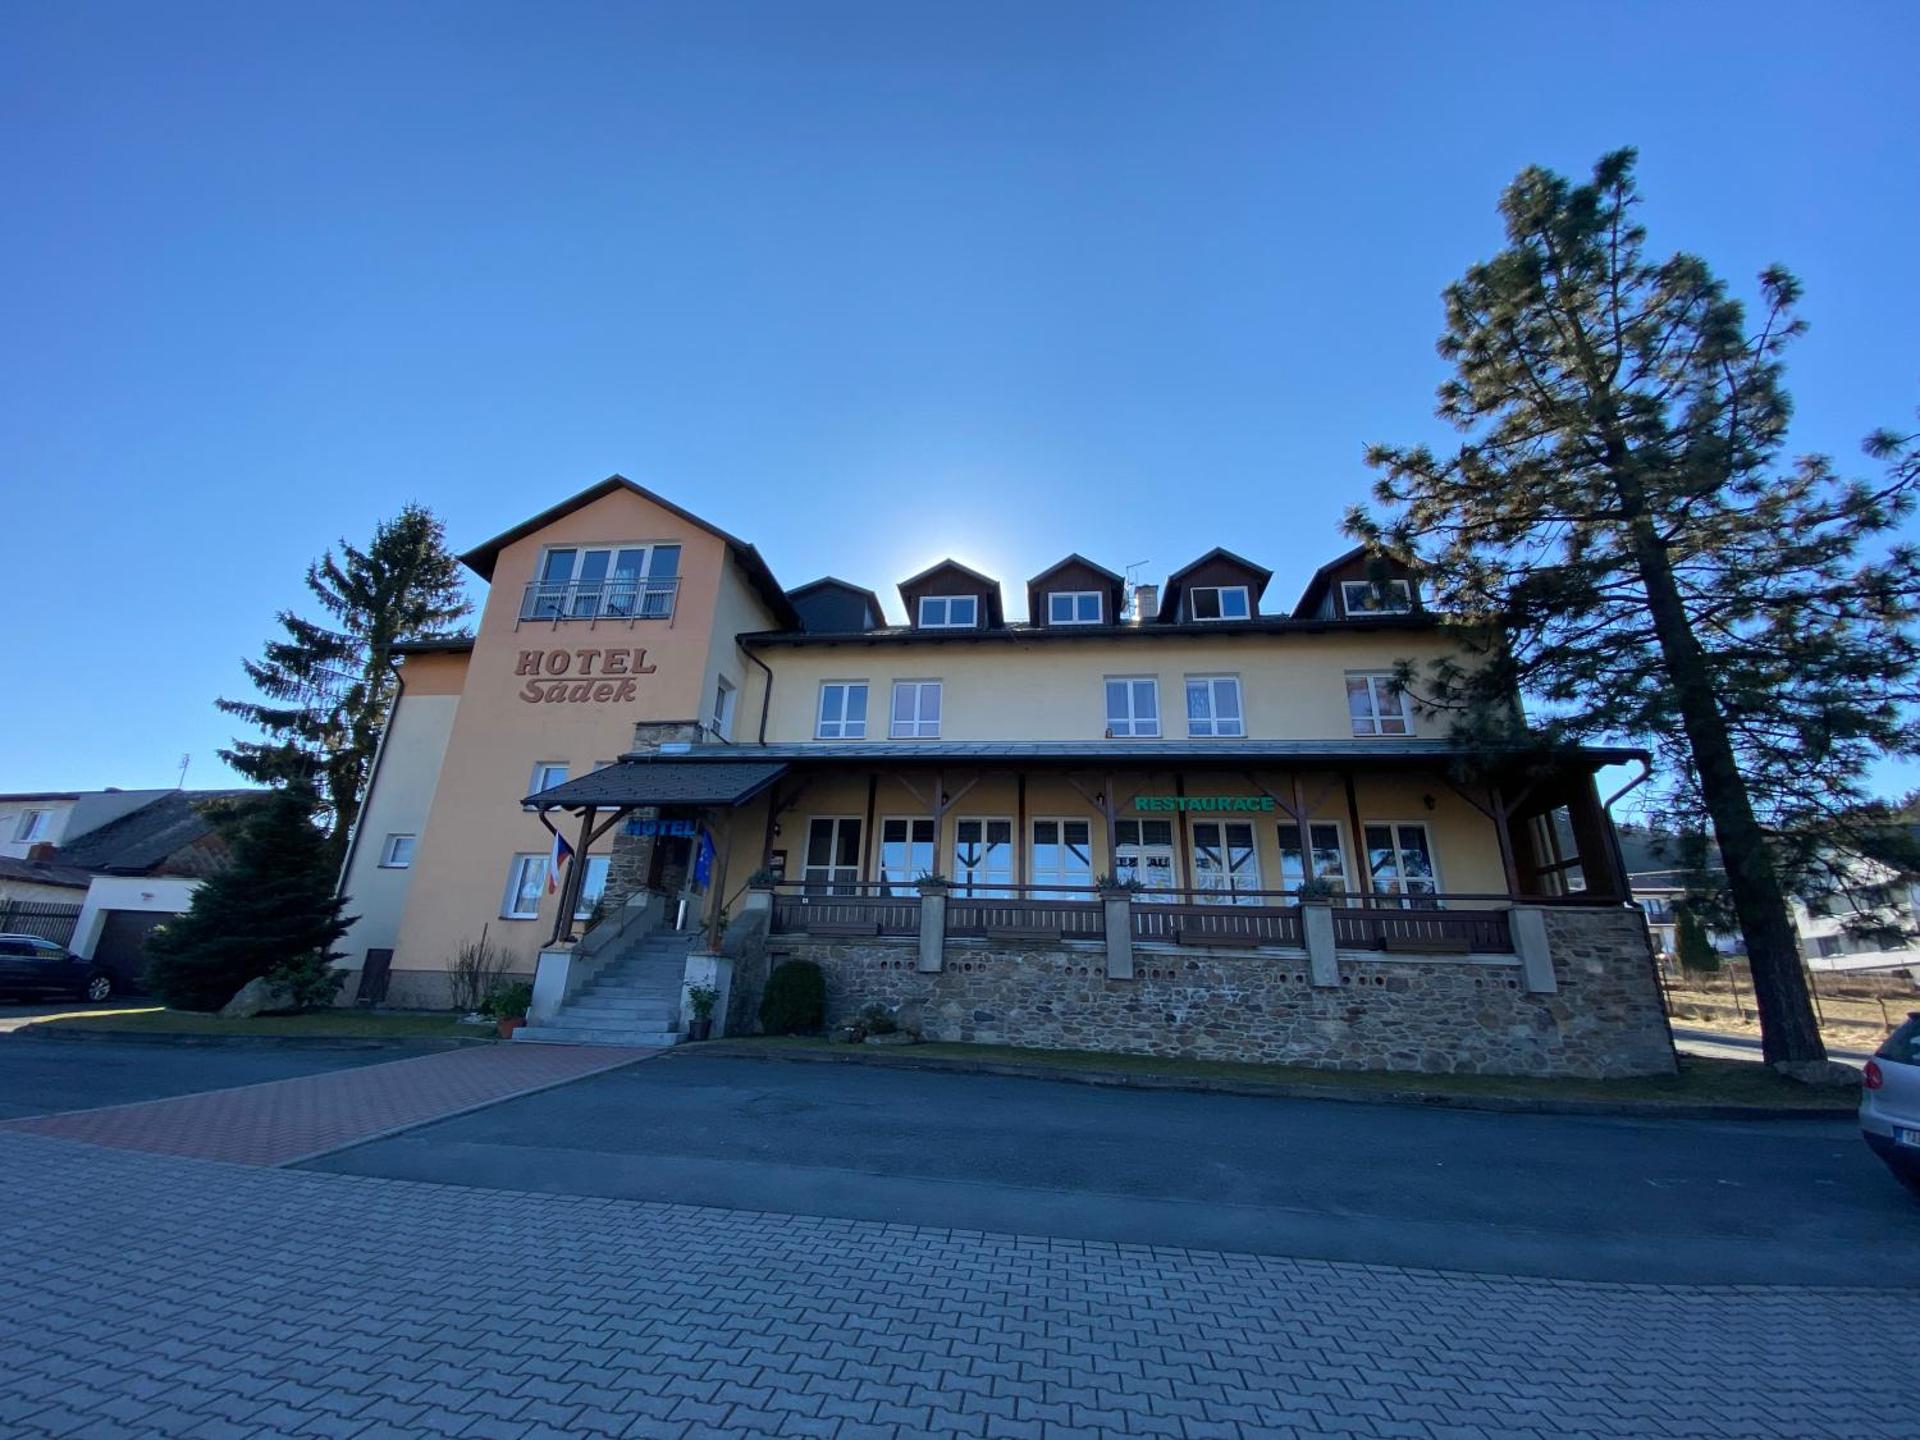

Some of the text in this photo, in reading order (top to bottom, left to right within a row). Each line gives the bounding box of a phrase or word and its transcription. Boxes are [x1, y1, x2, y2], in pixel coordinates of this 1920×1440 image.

[514, 648, 657, 676] HOTEL
[1135, 796, 1275, 811] RESTAURACE
[625, 819, 695, 836] HOTEL
